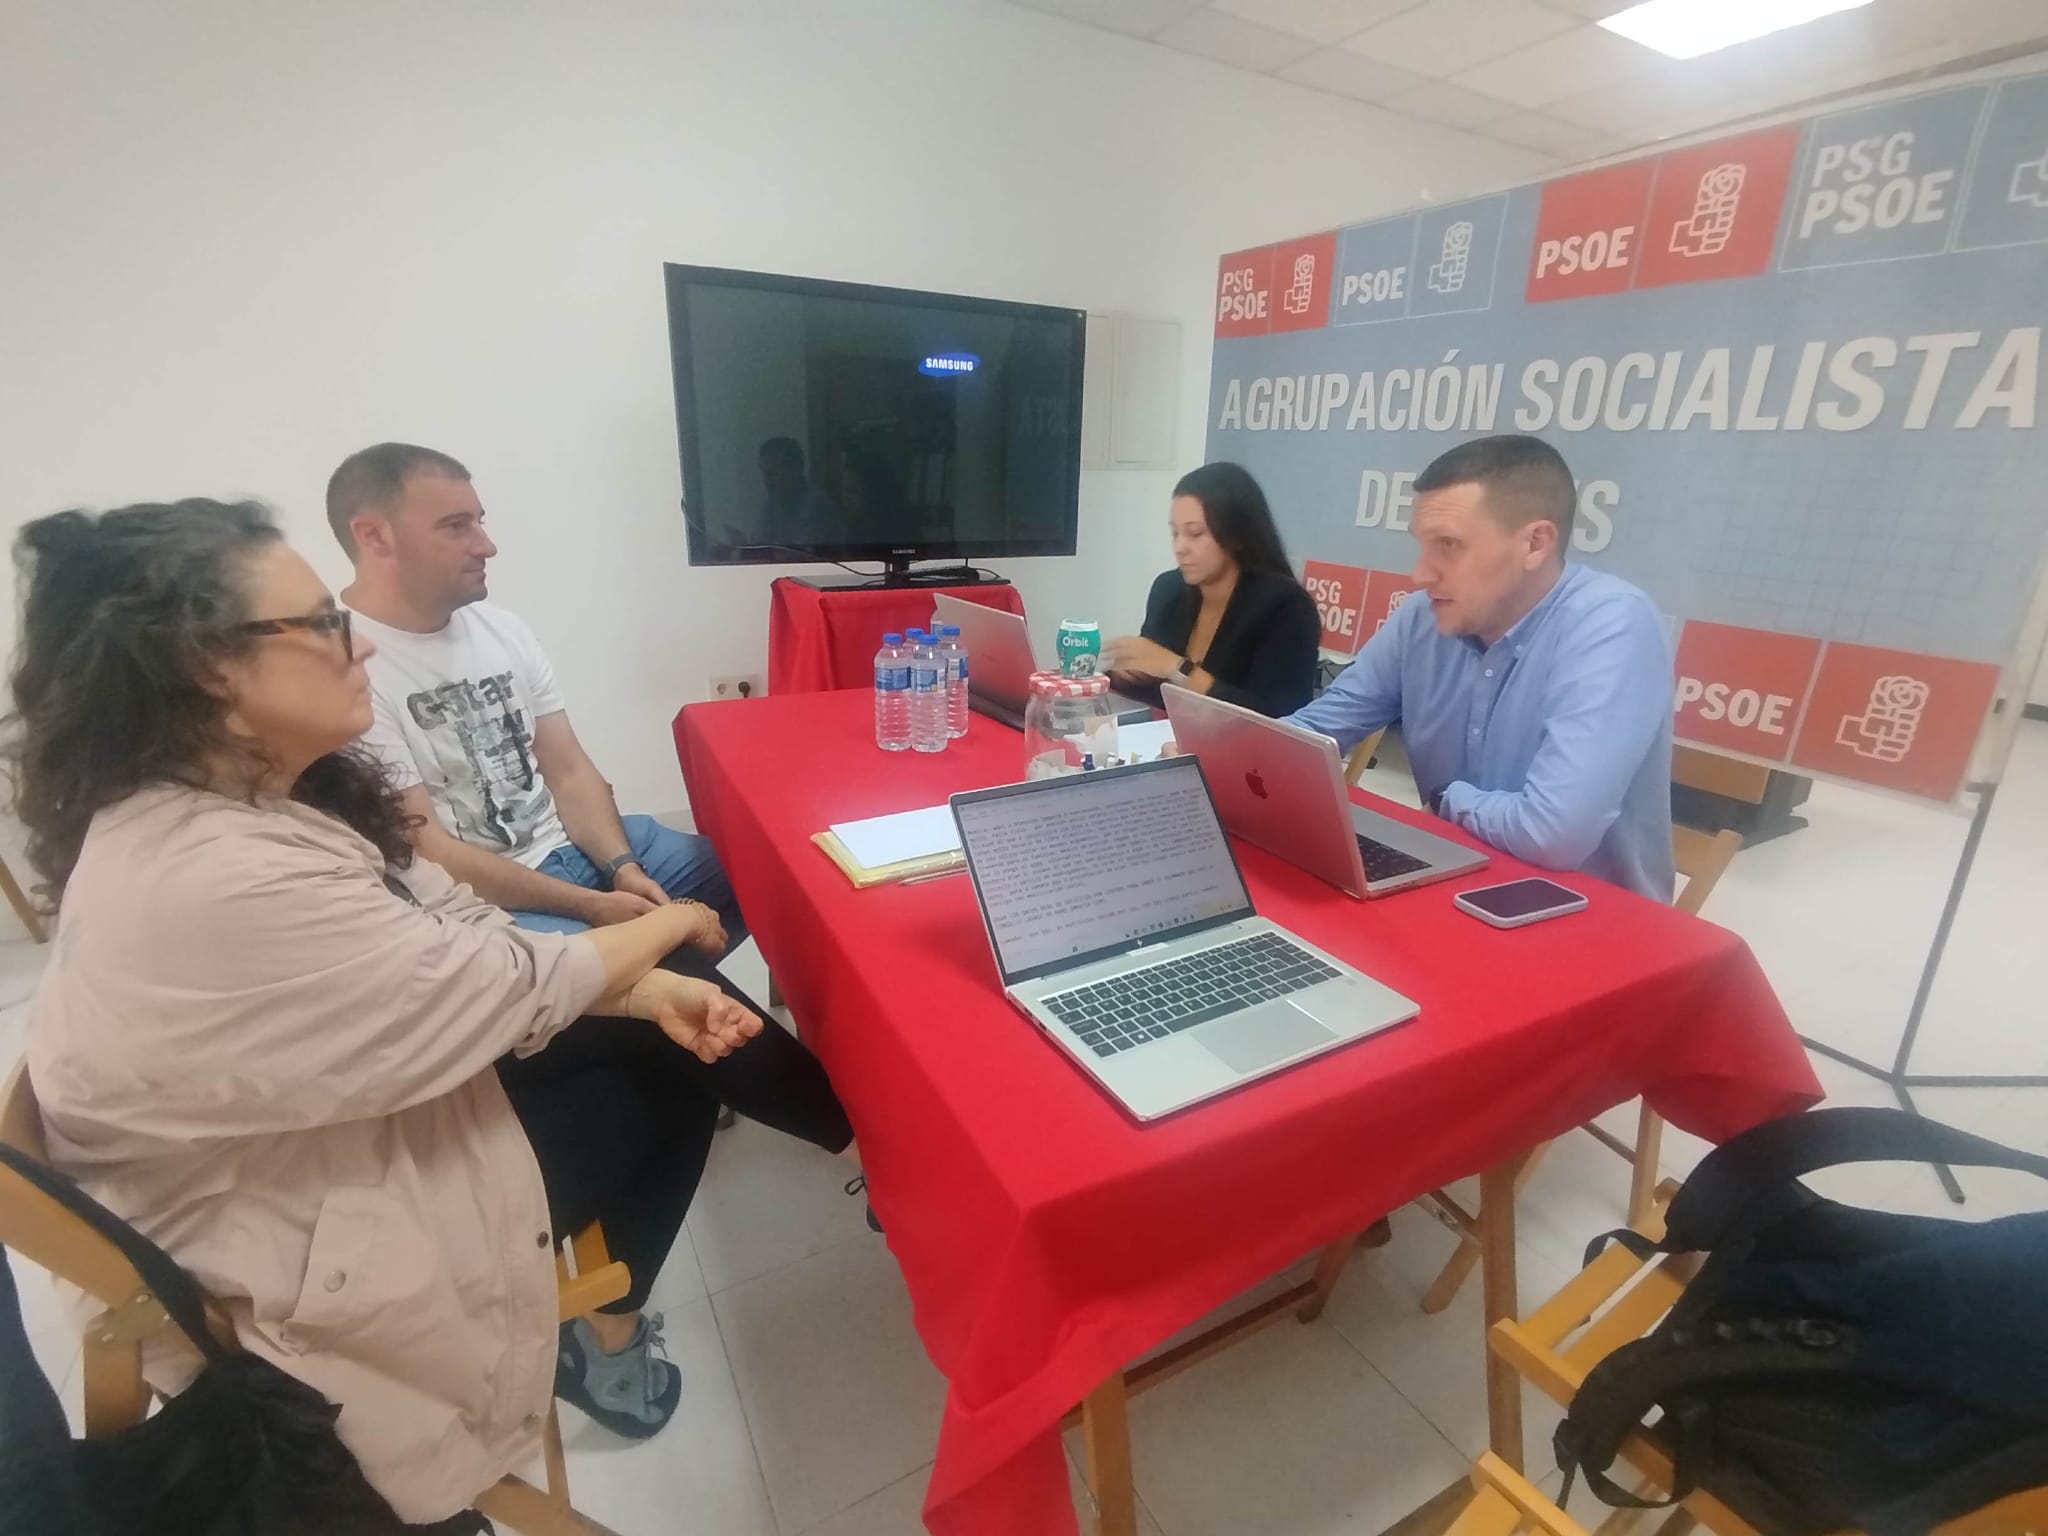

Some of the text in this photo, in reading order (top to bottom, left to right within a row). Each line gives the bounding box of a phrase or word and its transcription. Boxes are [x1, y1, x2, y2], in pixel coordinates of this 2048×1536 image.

[1812, 131, 1915, 188] PSG
[1799, 168, 1954, 240] PSOE
[1536, 226, 1635, 279] PSOE
[1221, 267, 1254, 294] PSG
[1342, 266, 1407, 306] PSOE
[1218, 290, 1268, 322] PSOE
[926, 357, 974, 372] SAMSUNG
[1218, 326, 2042, 433] AGRUPACIÓN SOCIALISTA
[1354, 469, 1418, 532] DE
[1305, 576, 1342, 604] PSG
[1316, 602, 1357, 637] SOE
[1062, 635, 1089, 648] Orbit
[1673, 676, 1793, 735] PSOE
